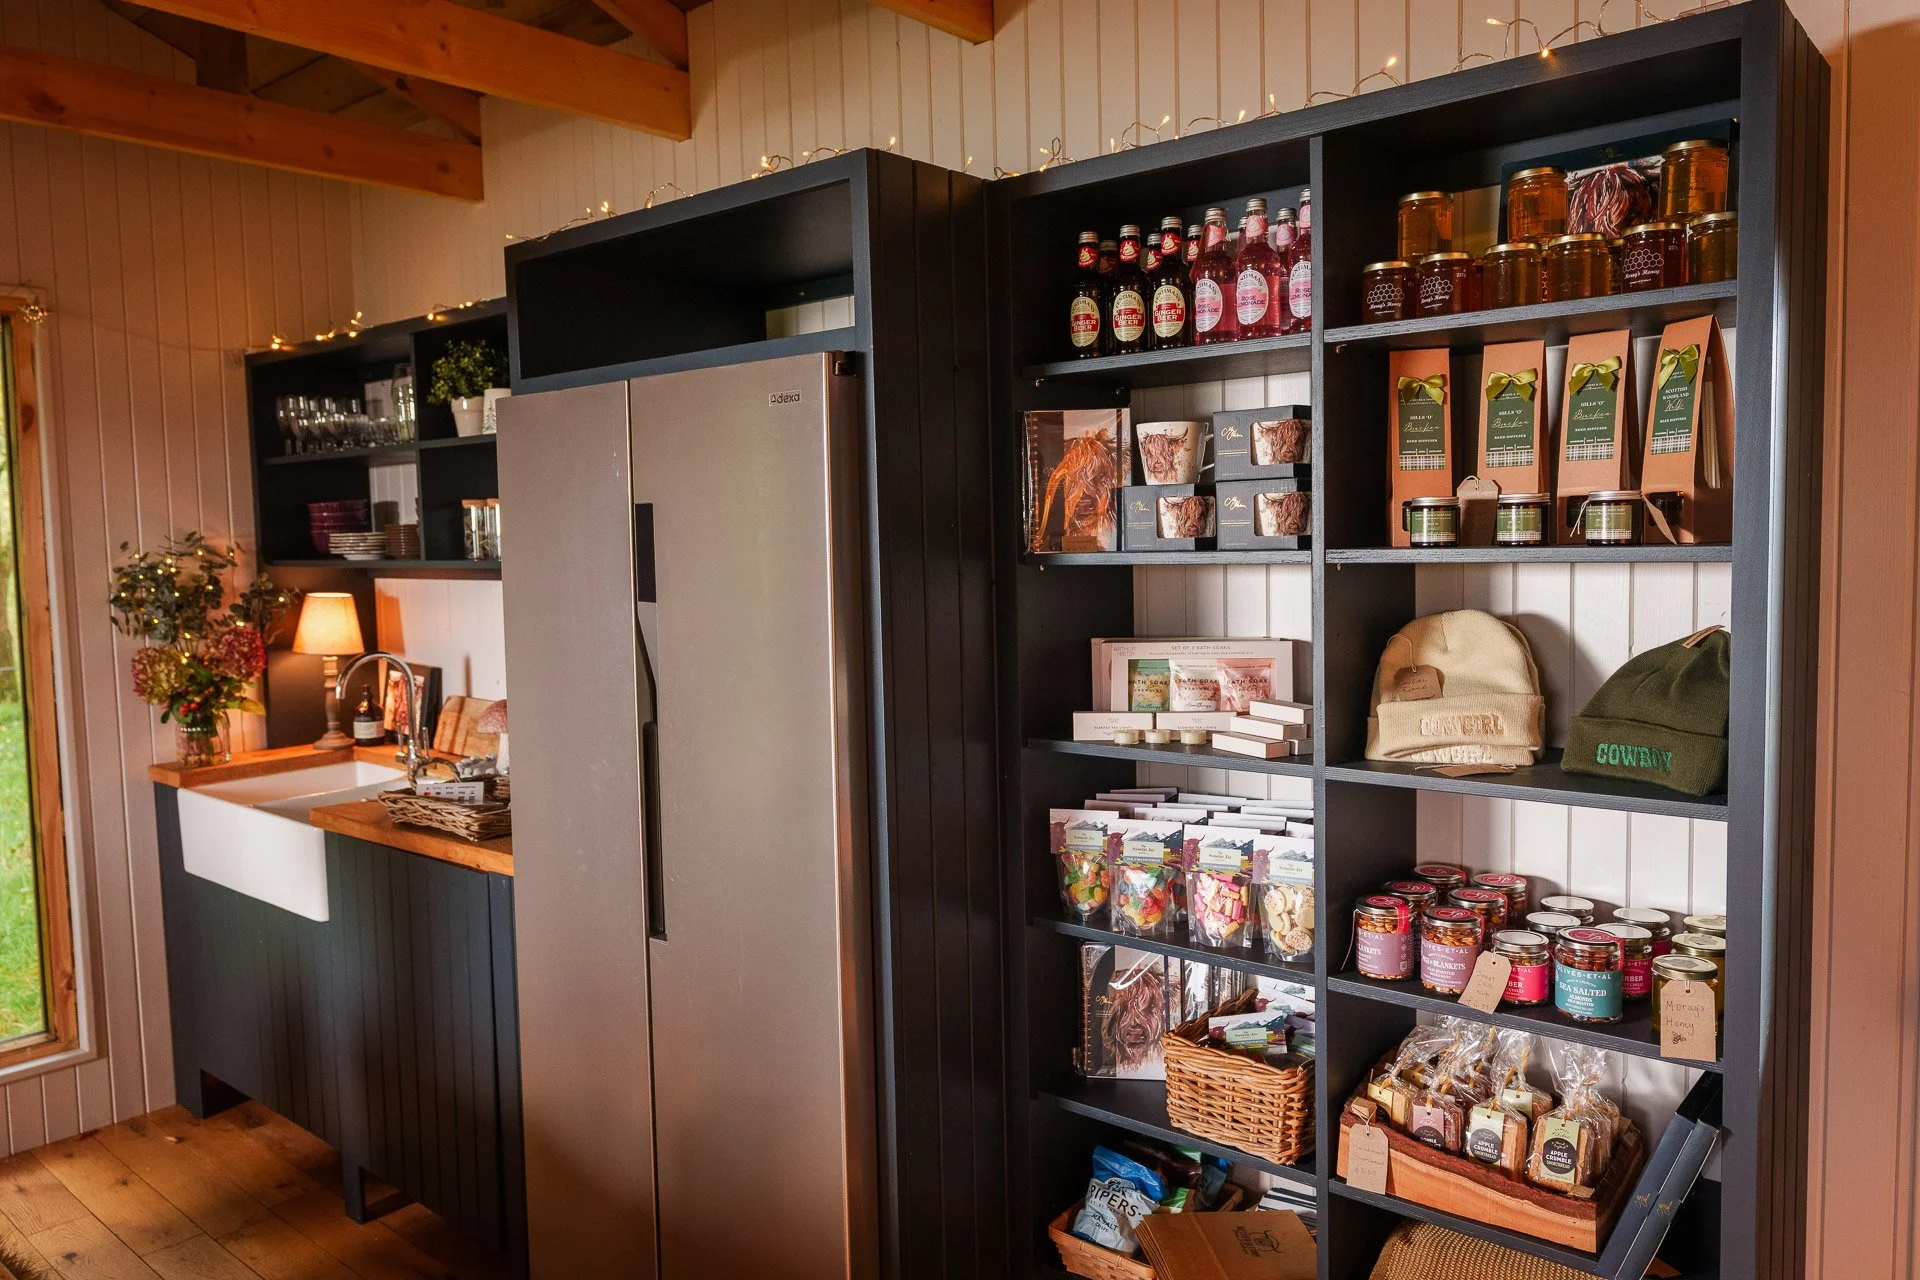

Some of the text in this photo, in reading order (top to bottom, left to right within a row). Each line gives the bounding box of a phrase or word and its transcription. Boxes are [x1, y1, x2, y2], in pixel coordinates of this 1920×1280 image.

[1114, 313, 1142, 321] GINGER
[1154, 308, 1182, 317] GINGER
[1157, 314, 1178, 322] BEER
[1071, 319, 1097, 327] GINGER
[1073, 324, 1092, 332] BEER
[1664, 386, 1688, 394] SCOTTISH
[770, 392, 801, 405] Adexa
[1662, 392, 1690, 400] WOODLAND
[1420, 713, 1505, 737] COWGIRL
[1596, 743, 1673, 774] COWBOY
[1559, 981, 1607, 997] SEA SALTED
[1568, 994, 1593, 1003] ALMONDS
[1665, 1000, 1705, 1018] Morag's
[1666, 1018, 1695, 1036] Honey
[1478, 1140, 1495, 1149] APPLE
[1473, 1144, 1498, 1156] CRUMBLE
[1550, 1150, 1568, 1158] APPLE
[1545, 1154, 1572, 1165] CRUMBLE
[1546, 1160, 1571, 1169] SHORTBREAD
[1101, 1219, 1118, 1231] SALT
